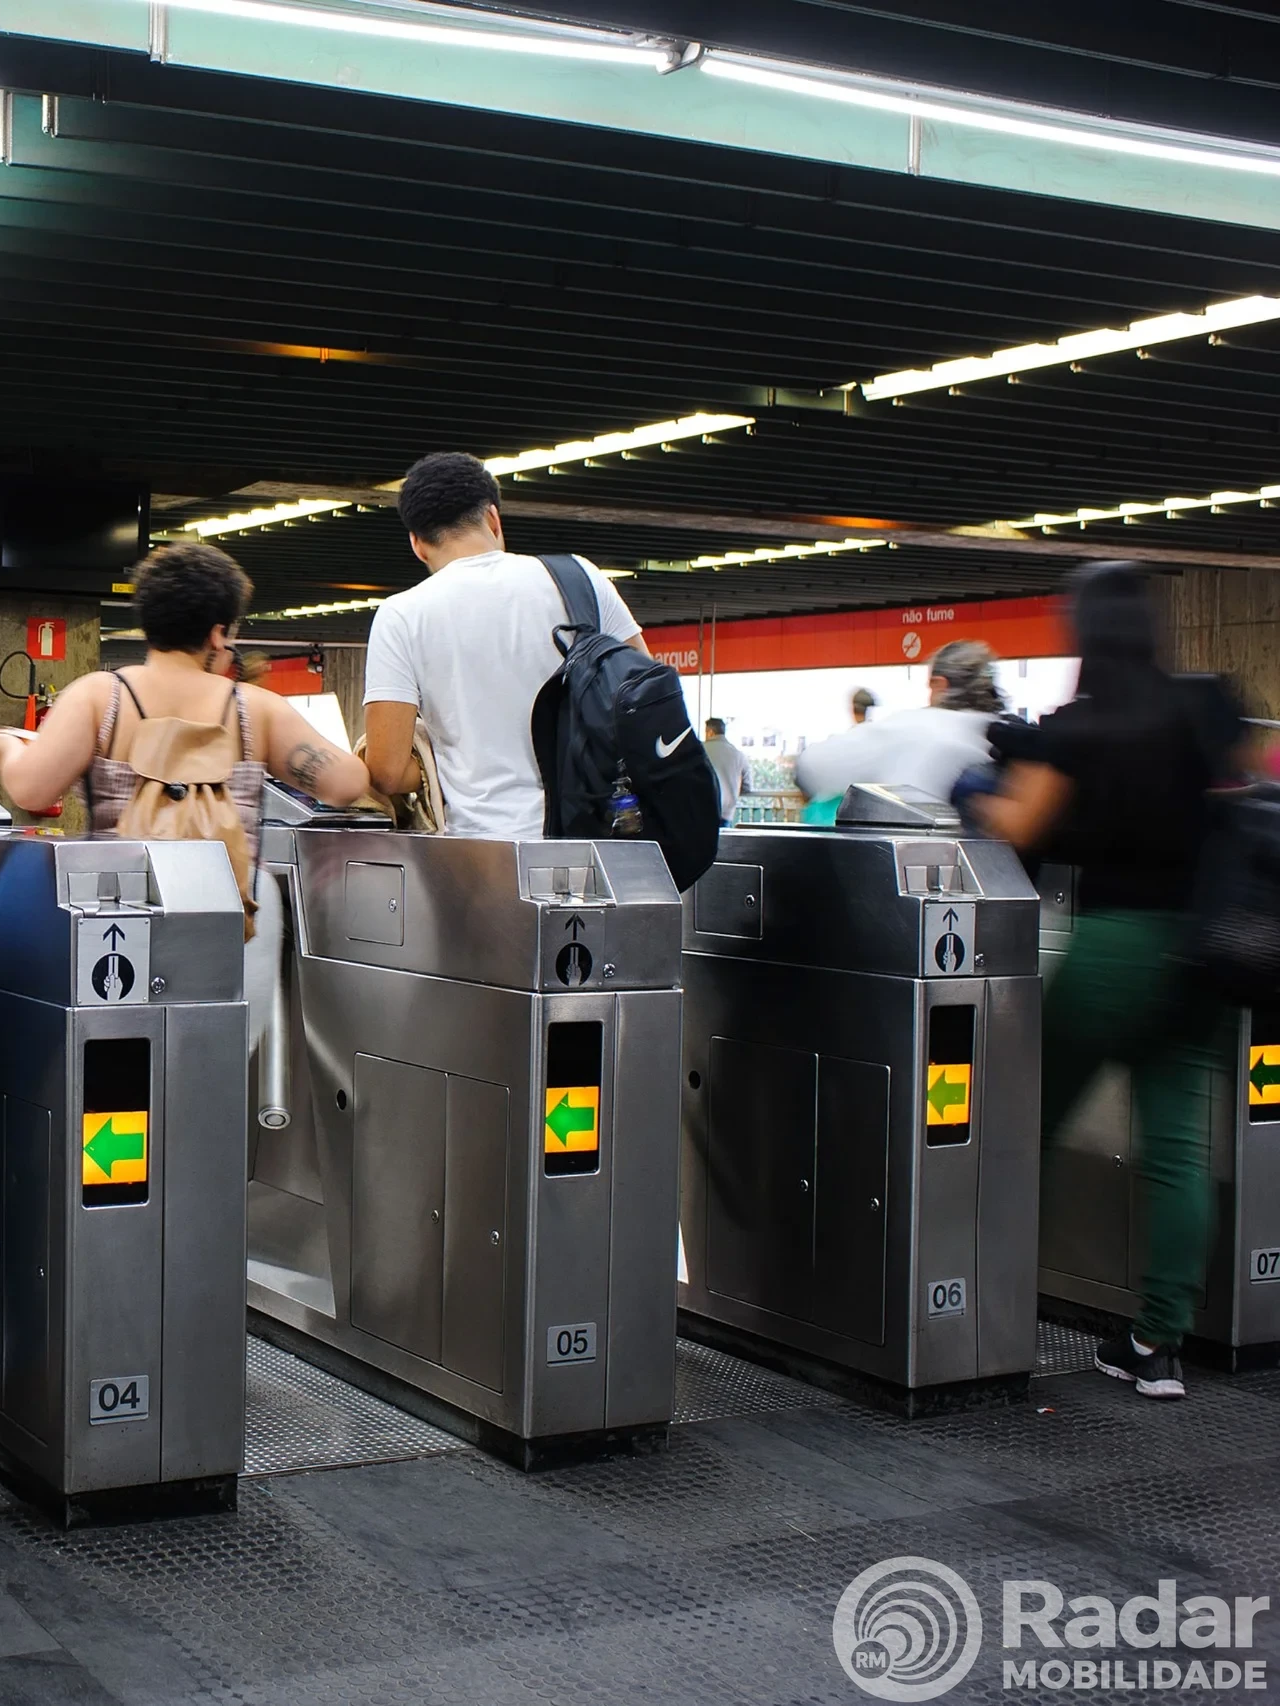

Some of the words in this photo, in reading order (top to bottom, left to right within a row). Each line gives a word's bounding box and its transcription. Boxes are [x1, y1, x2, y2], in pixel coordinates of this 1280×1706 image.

[902, 609, 923, 624] não
[927, 608, 955, 622] fume
[1257, 1252, 1280, 1275] 07
[933, 1282, 961, 1309] 06
[557, 1329, 588, 1356] 05
[99, 1382, 140, 1411] 04
